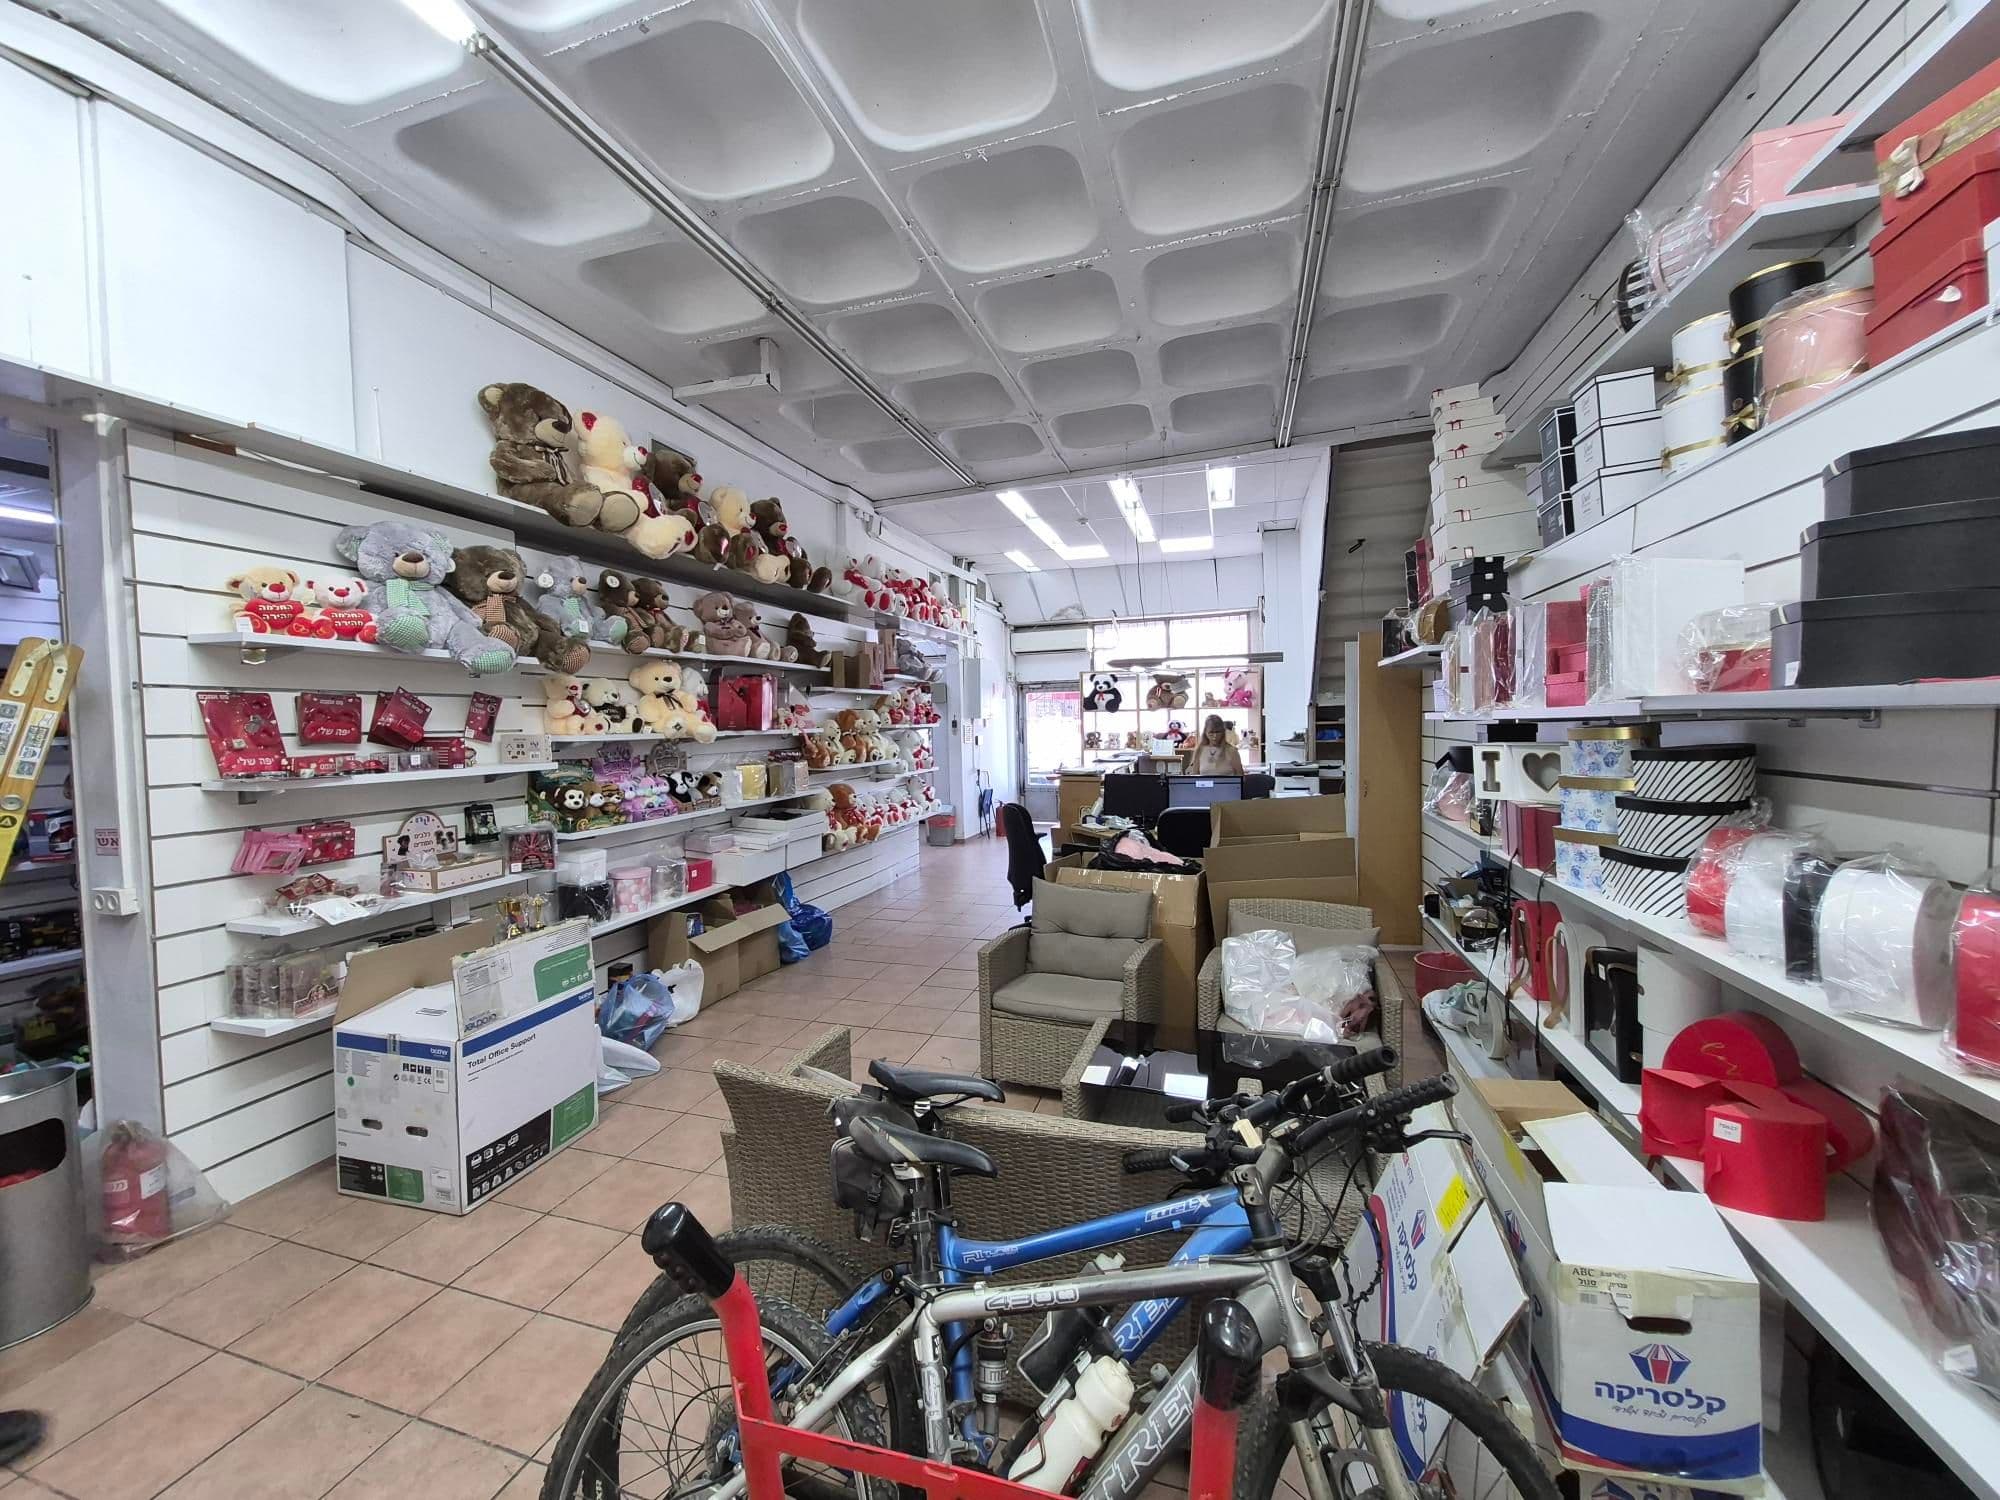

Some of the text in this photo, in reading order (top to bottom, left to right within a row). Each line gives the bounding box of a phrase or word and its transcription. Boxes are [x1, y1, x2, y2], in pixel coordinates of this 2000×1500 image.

[97, 837, 120, 847] אש
[467, 1055, 486, 1068] Total
[488, 1046, 509, 1060] Office
[510, 1033, 536, 1050] Support
[1572, 1267, 1595, 1277] ABC
[1594, 1381, 1727, 1416] קלסריקה
